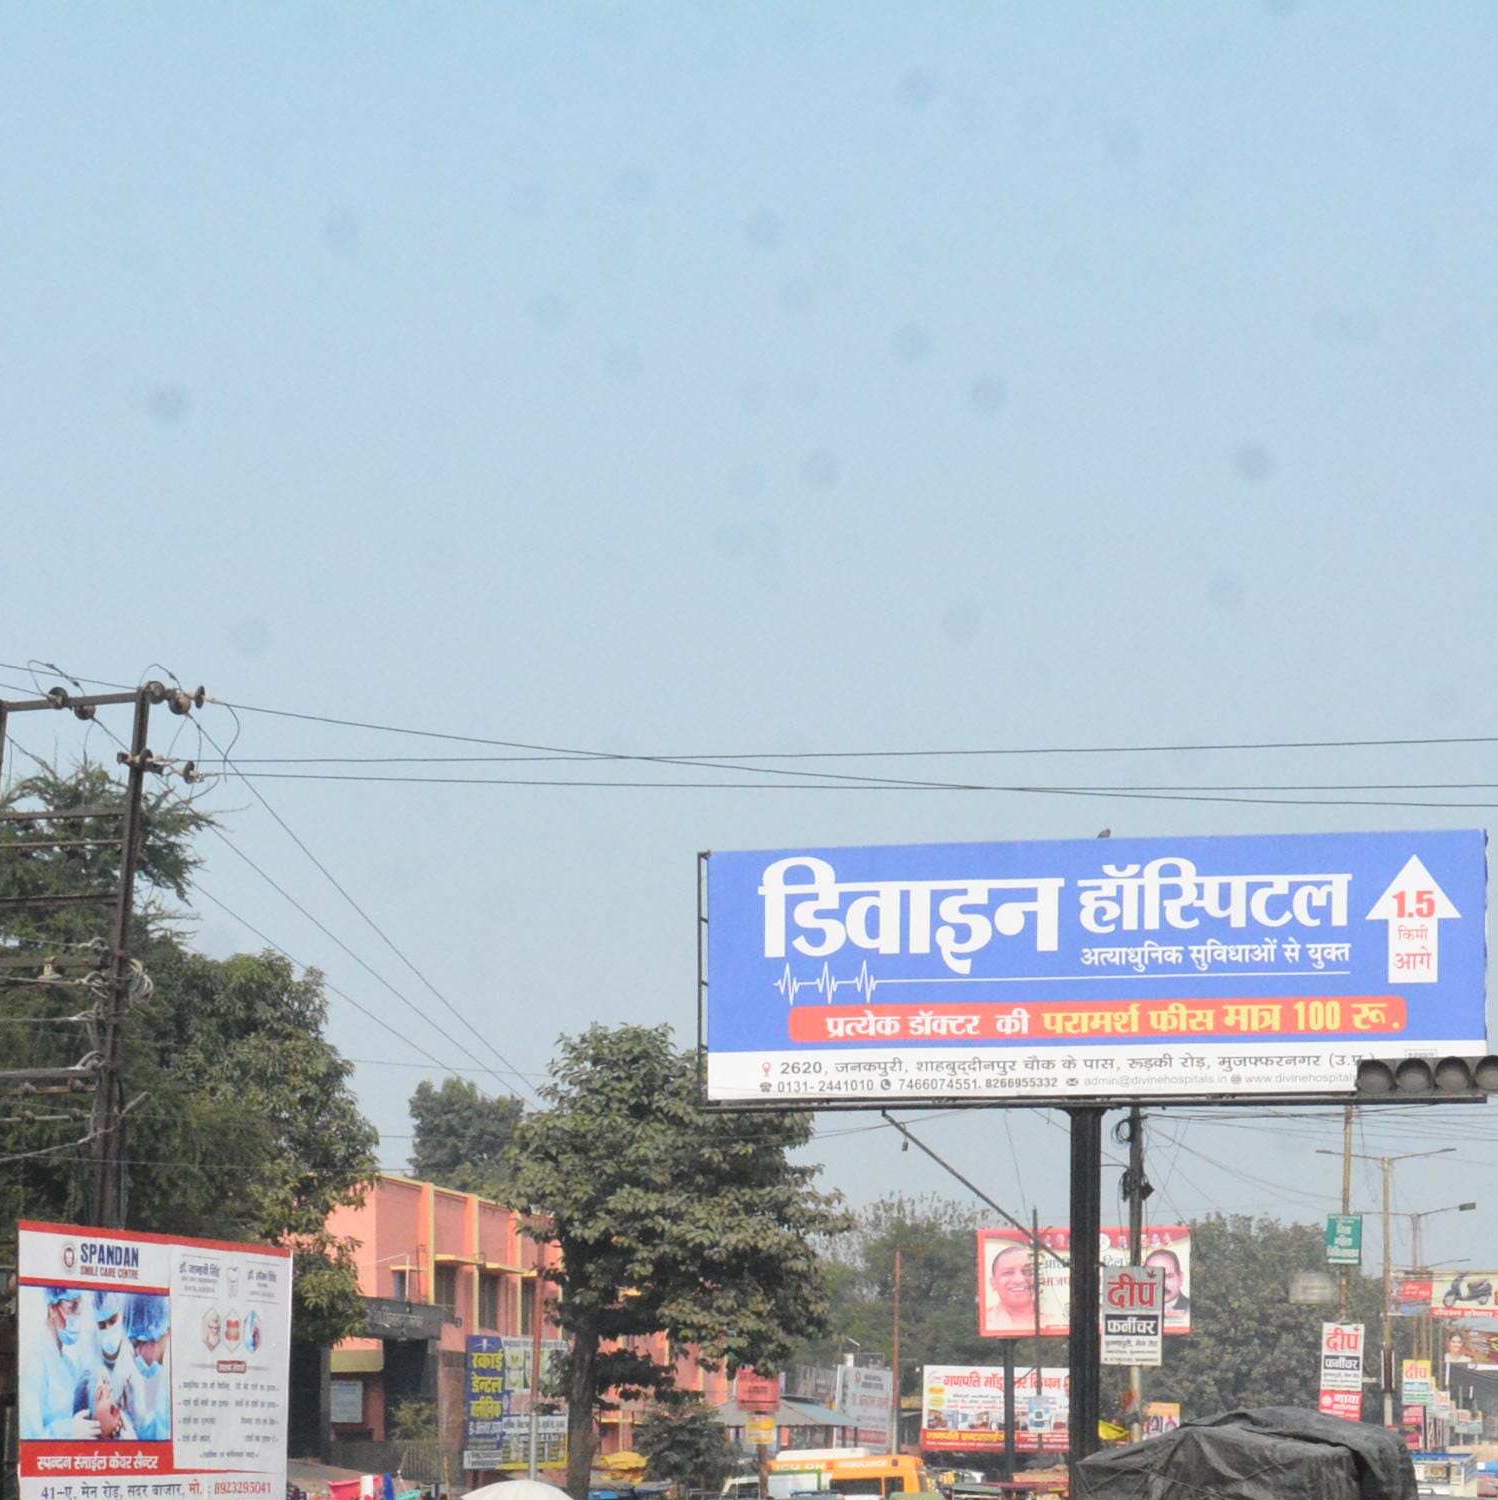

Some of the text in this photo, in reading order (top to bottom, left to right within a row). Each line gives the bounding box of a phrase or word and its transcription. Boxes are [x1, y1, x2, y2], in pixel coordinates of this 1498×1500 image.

[757, 856, 1353, 975] डिवाइन हॉस्पिटल
[1391, 889, 1436, 919] 1.5
[1397, 924, 1429, 942] किमी
[1080, 936, 1352, 973] अत्याधुनिक सुविधाओं से युक्त
[1393, 949, 1432, 972] आगे
[825, 1010, 901, 1037] प्रत्येक
[908, 1010, 981, 1036] डॉक्टर
[995, 1007, 1029, 1035] की
[1041, 1002, 1141, 1034] परामर्श
[1149, 1002, 1216, 1033] फीस
[1222, 1003, 1282, 1031] मात्र
[1293, 1000, 1341, 1031] 100
[1023, 1055, 1056, 1072] चौक
[1061, 1055, 1077, 1071] के
[818, 1080, 874, 1092] 2441010
[985, 1077, 1059, 1089] 8266955332
[80, 1243, 139, 1268] SPANDAN
[118, 1267, 139, 1280] CENTRE
[1107, 1272, 1158, 1309] दीप
[1106, 1316, 1157, 1335] फर्नीचर
[1326, 1327, 1361, 1352] दीप
[80, 1482, 98, 1500] मेन
[127, 1484, 149, 1498] सदर
[214, 1481, 272, 1495] 8923295041
